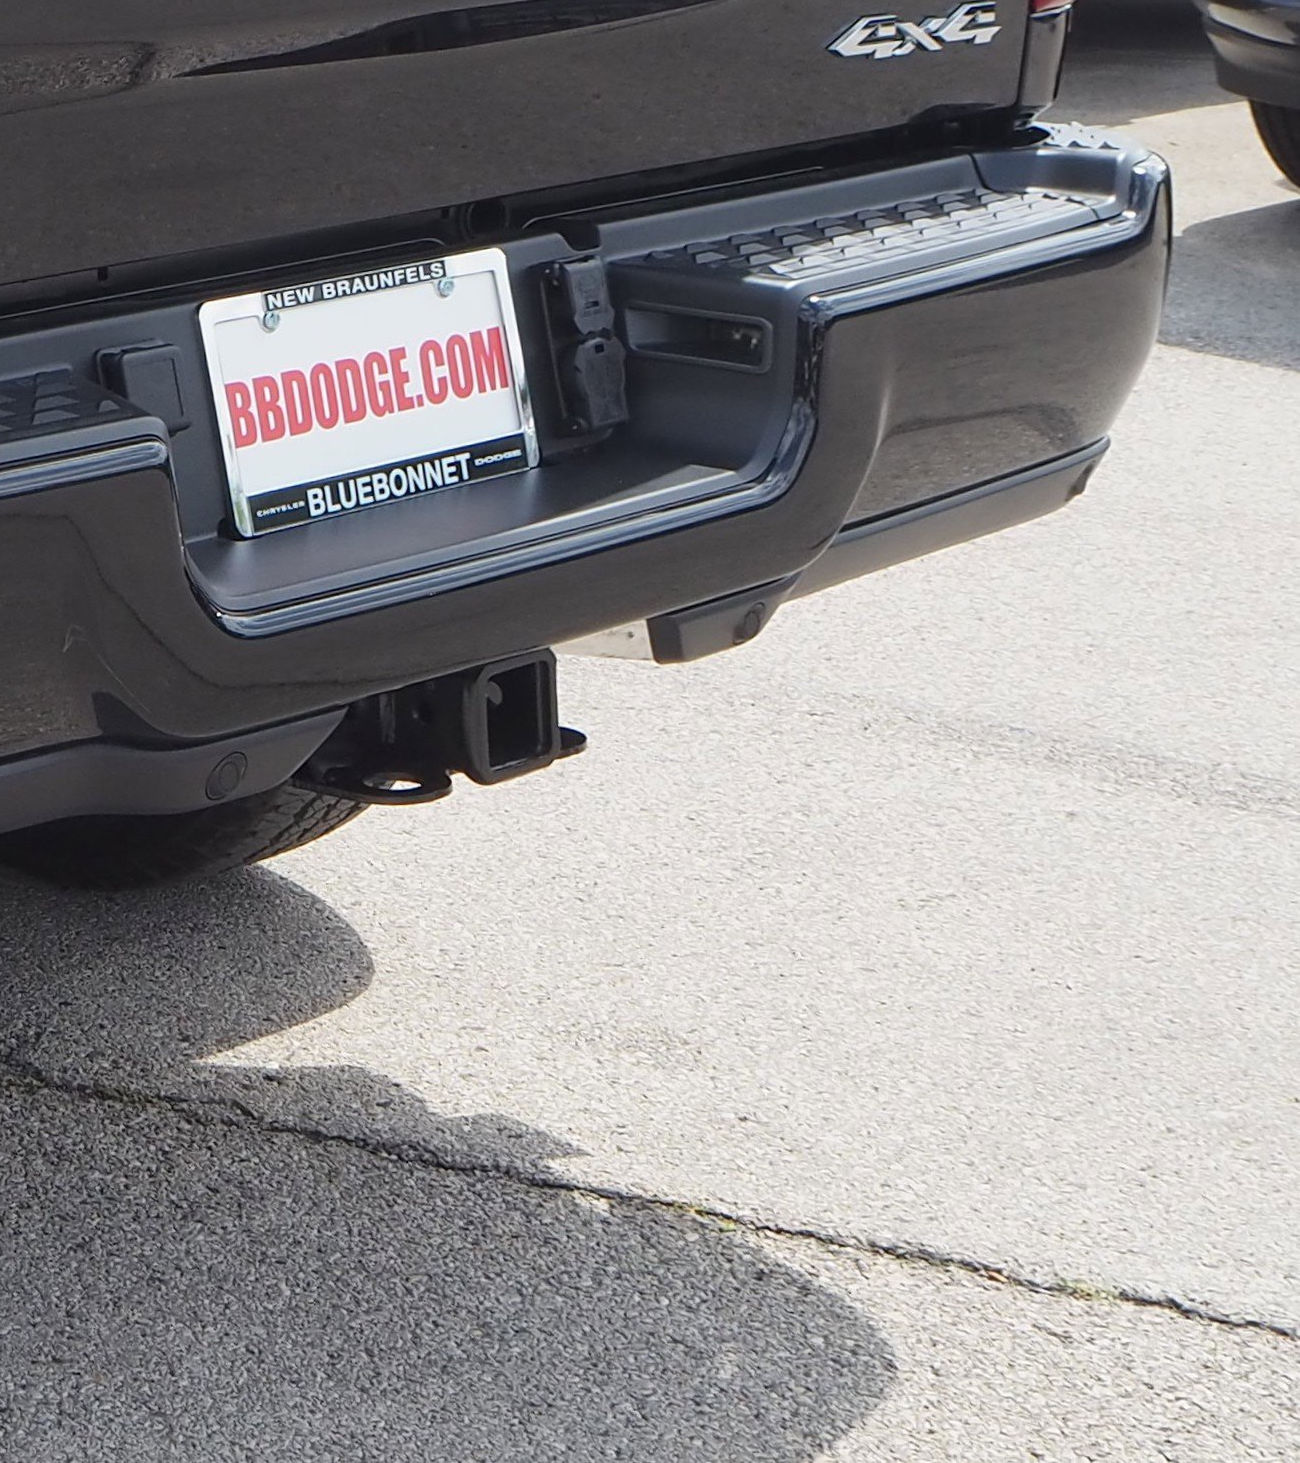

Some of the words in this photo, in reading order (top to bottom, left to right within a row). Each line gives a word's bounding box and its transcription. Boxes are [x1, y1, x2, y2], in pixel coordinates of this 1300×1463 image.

[267, 285, 315, 310] NEW
[321, 262, 445, 300] BRAUNFELS
[224, 326, 510, 449] BBDODGE.COM
[256, 500, 306, 519] CHRYSLER
[307, 453, 471, 518] BLUEBONNET
[474, 448, 523, 468] DODGE
